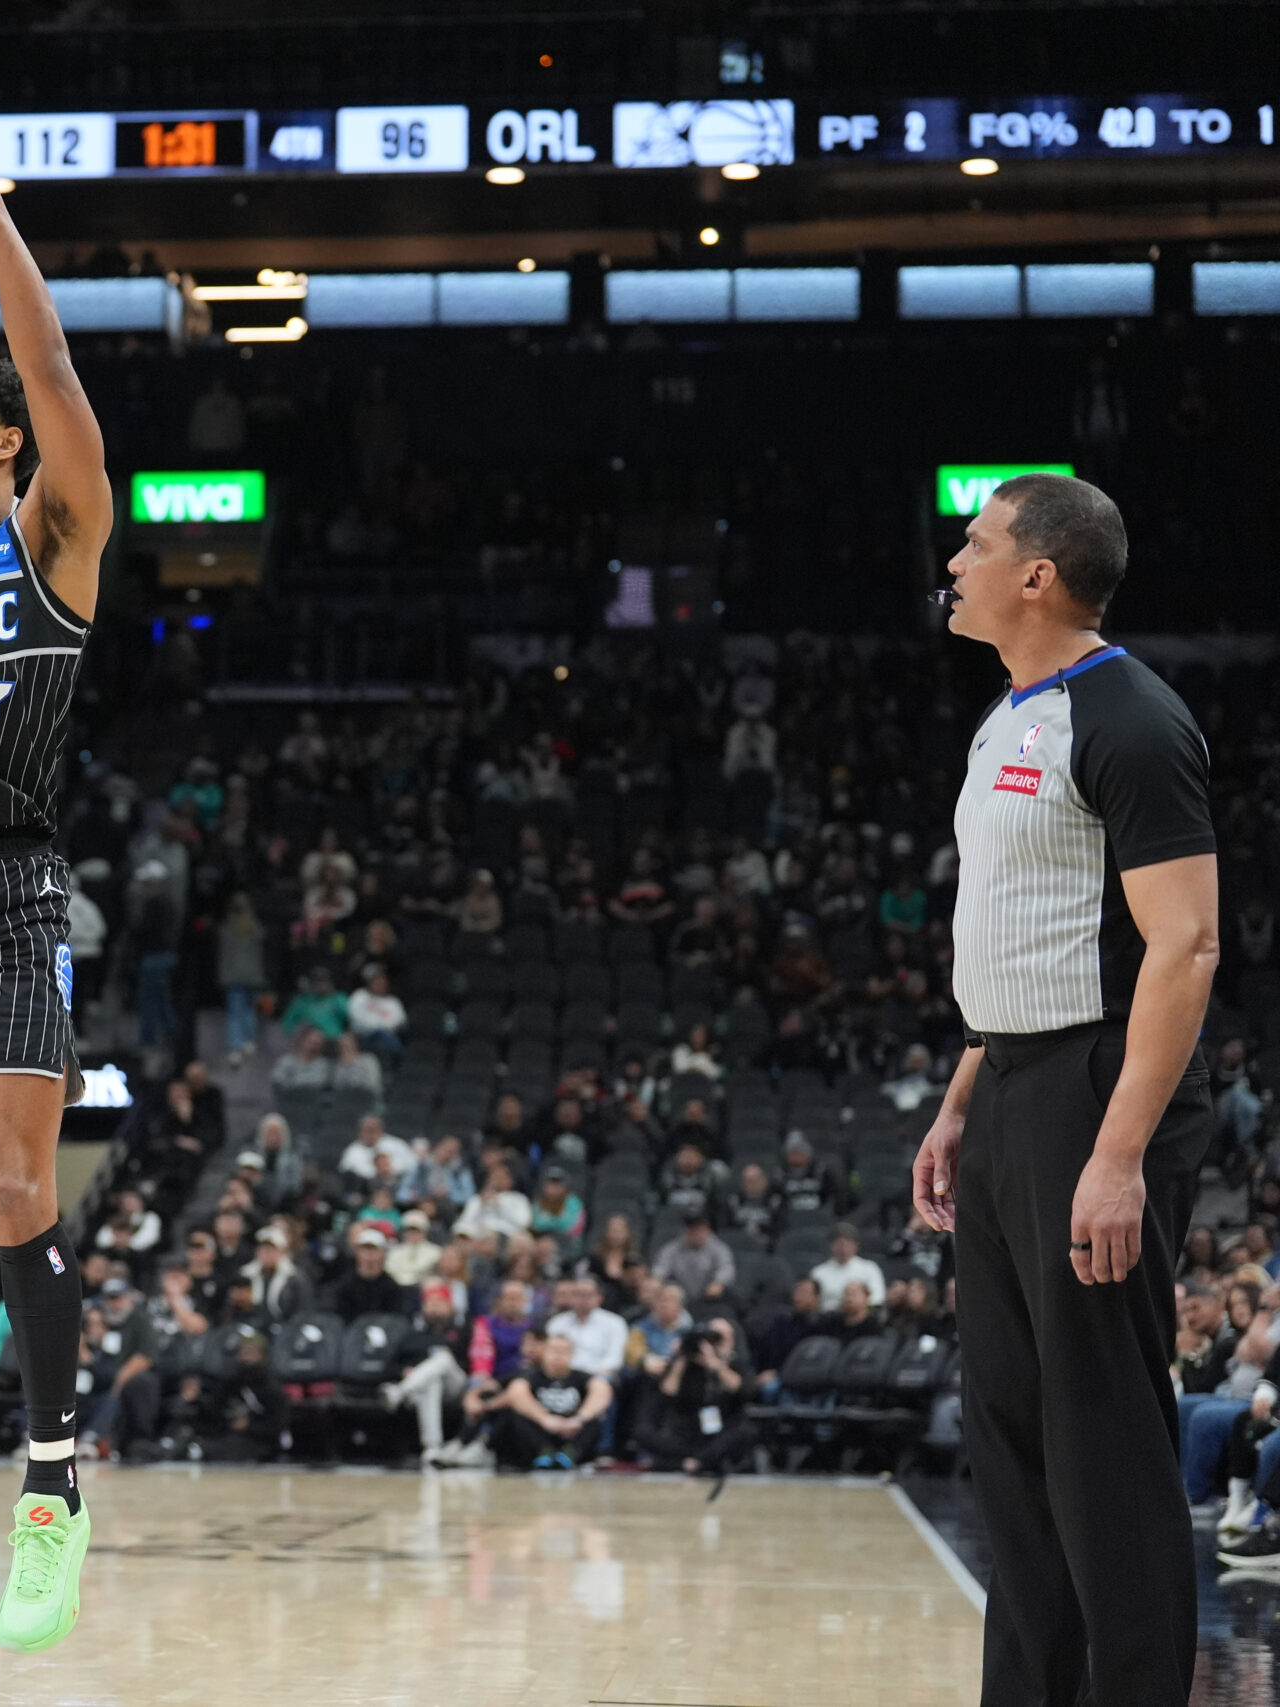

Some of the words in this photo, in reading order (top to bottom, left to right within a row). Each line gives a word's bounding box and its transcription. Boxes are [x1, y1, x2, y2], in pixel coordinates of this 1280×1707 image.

[382, 121, 427, 160] 96
[486, 108, 596, 164] ORL
[819, 115, 879, 150] PF
[969, 110, 1079, 148] FG%
[1168, 108, 1233, 144] TO
[1258, 104, 1275, 145] 1
[18, 128, 80, 166] 112
[143, 121, 216, 168] 1:31
[996, 770, 1039, 791] Emirates
